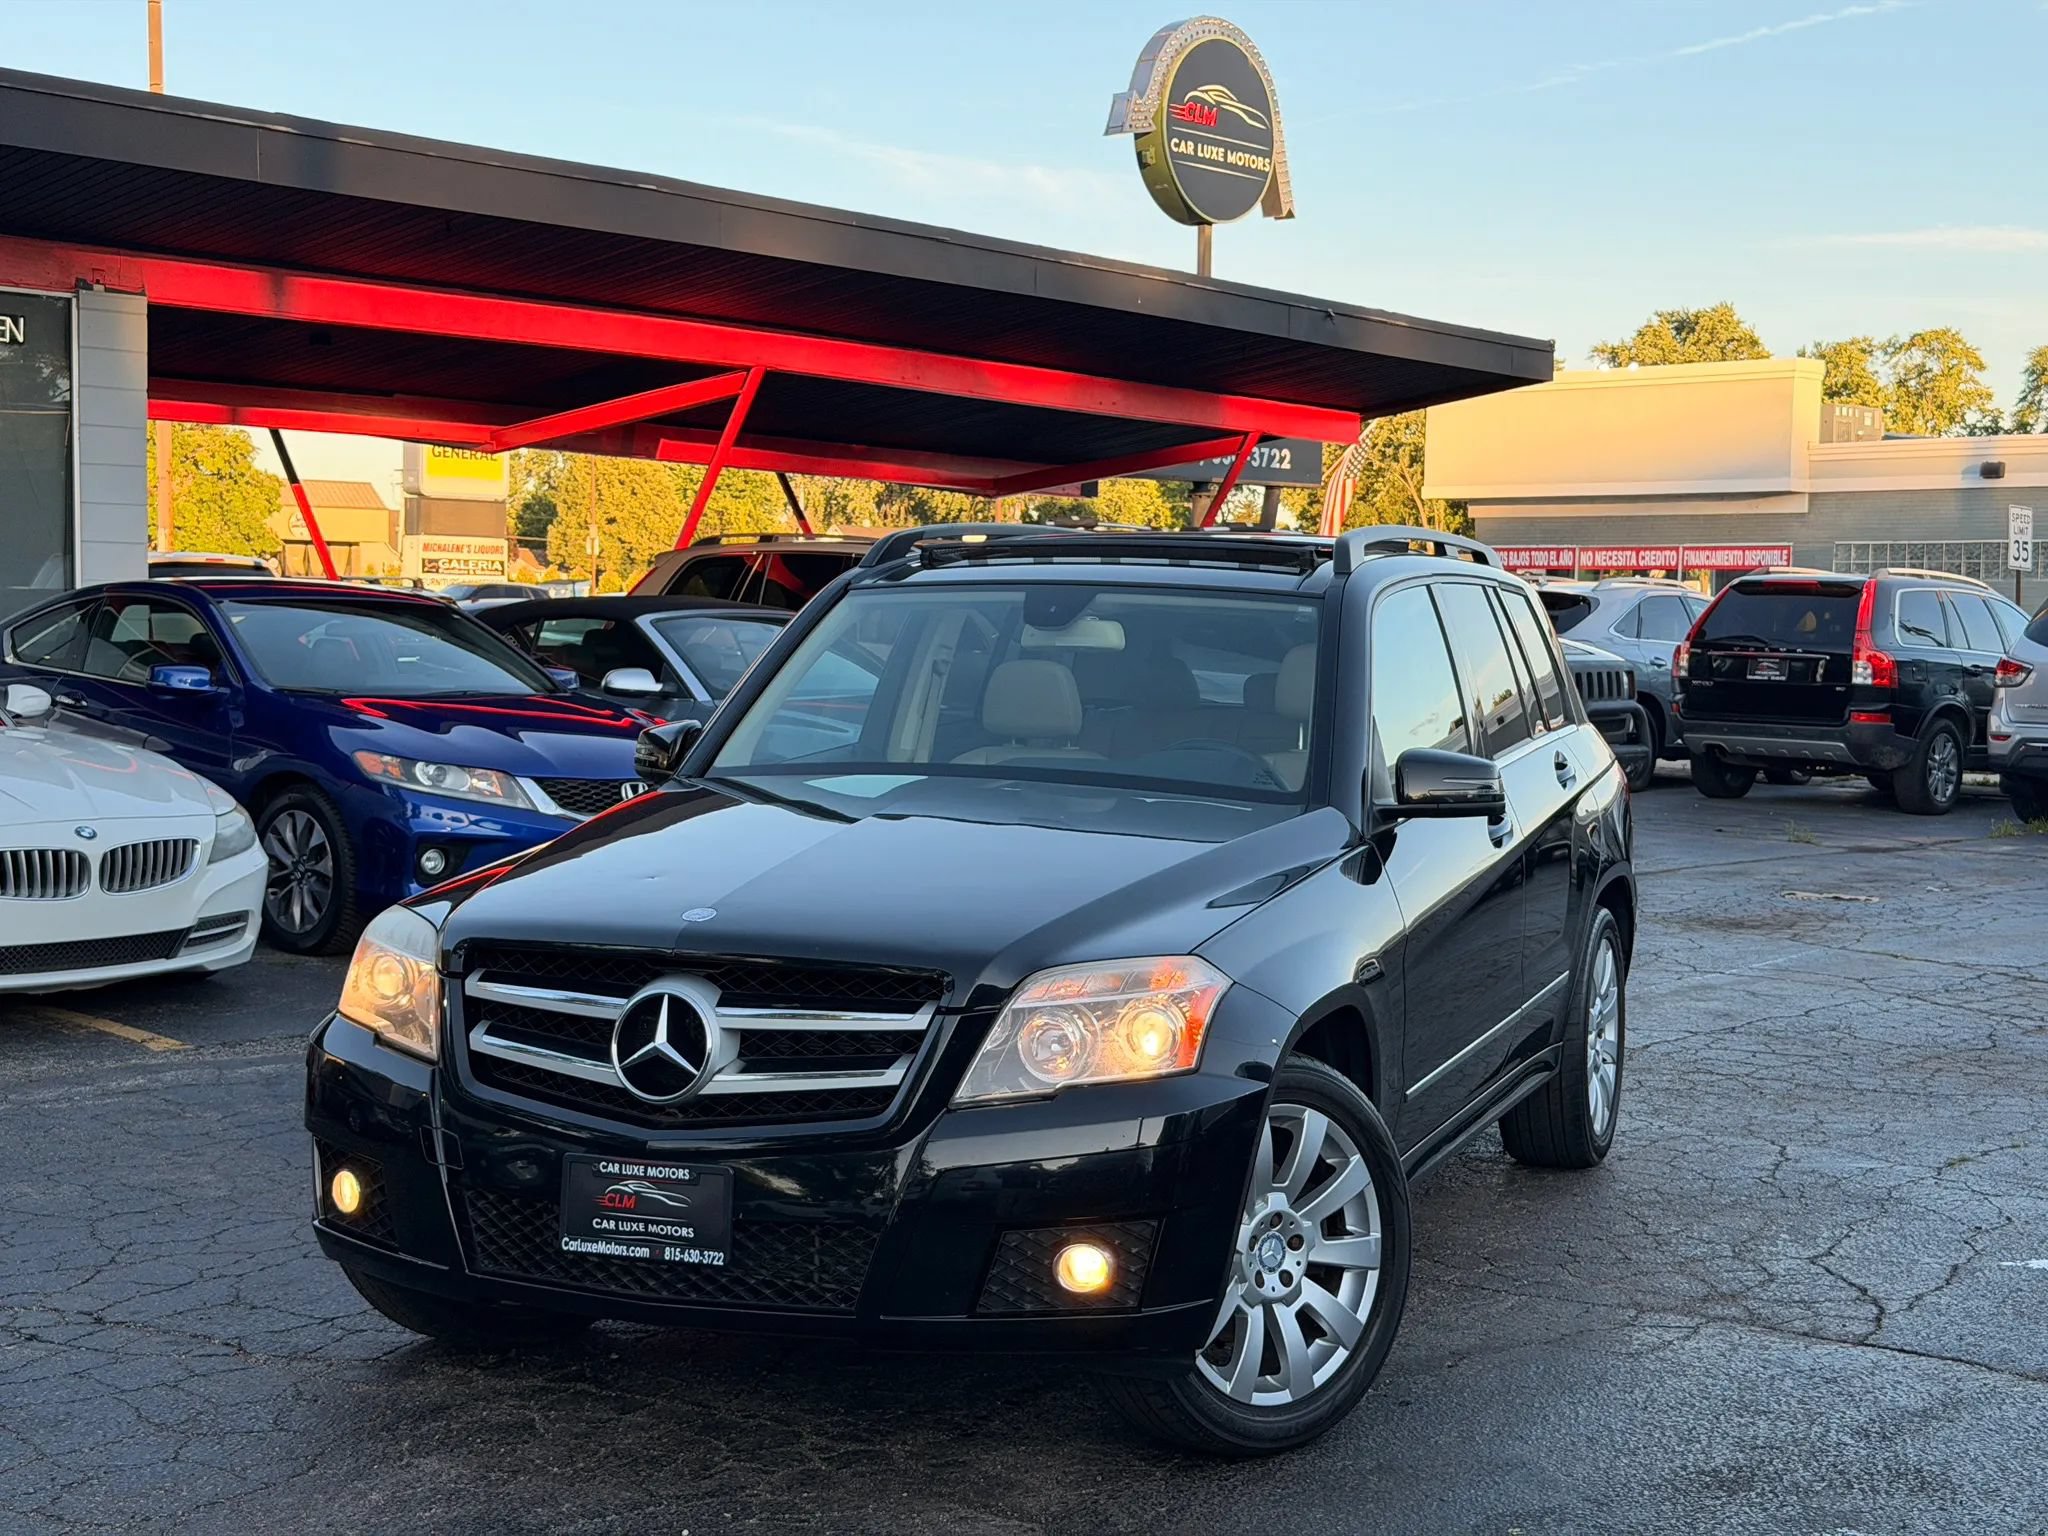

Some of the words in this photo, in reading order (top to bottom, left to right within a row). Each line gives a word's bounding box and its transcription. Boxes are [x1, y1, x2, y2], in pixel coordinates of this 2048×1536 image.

[1184, 101, 1218, 128] CLM
[1170, 138, 1195, 155] CAR
[1197, 143, 1225, 162] LUXE
[1227, 150, 1271, 172] MOTORS
[2012, 513, 2031, 524] SPEED
[2014, 525, 2029, 535] LIMIT
[473, 545, 504, 555] LIQUORS
[1509, 550, 1530, 566] BAJOS
[1531, 550, 1548, 566] TODO
[1549, 550, 1558, 566] EL
[1559, 549, 1574, 566] AÑO
[1580, 550, 1593, 567] NO
[1595, 550, 1637, 566] NECESITA
[1638, 550, 1677, 566] CREDITO
[1684, 550, 1743, 566] FINANCIAMIENTO
[1744, 550, 1788, 566] DISPONIBLE
[2013, 540, 2029, 562] 35
[438, 558, 503, 571] GALERIA
[600, 1161, 620, 1174] CAR
[622, 1163, 645, 1176] LUXE
[647, 1166, 690, 1180] MOTORS
[604, 1192, 636, 1209] CLM
[592, 1218, 616, 1231] CAR
[619, 1221, 645, 1232] LUXE
[648, 1223, 695, 1238] MOTORS
[561, 1236, 650, 1258] CarLuxeMotors.com
[664, 1247, 725, 1266] 815-630-3722
